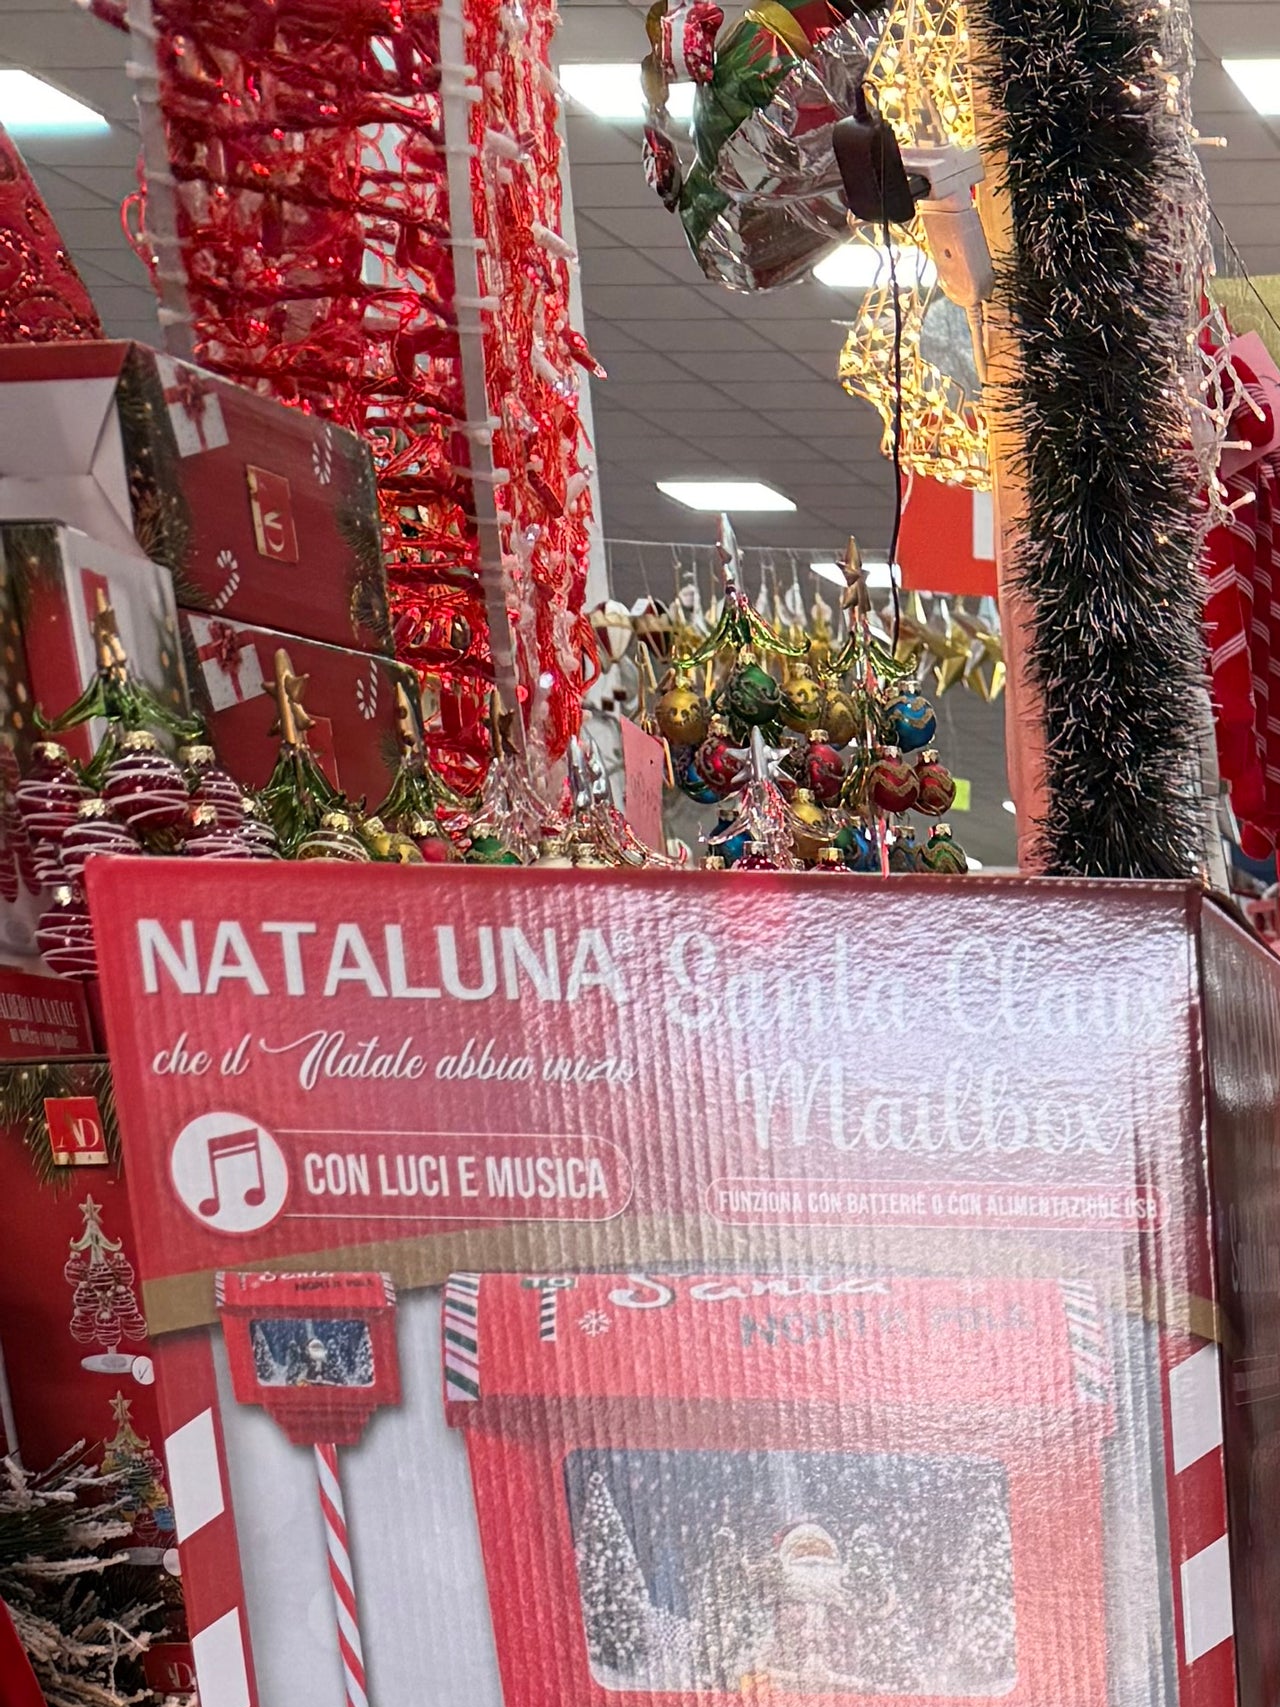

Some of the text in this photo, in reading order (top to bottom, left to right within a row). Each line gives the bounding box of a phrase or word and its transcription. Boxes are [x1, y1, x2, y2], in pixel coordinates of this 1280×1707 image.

[662, 930, 1167, 1048] Santa Claus
[152, 1029, 640, 1091] che il Natale abbia inizio
[736, 1058, 1134, 1157] Mailbox
[304, 1152, 609, 1200] CON LUCI E MUSICA
